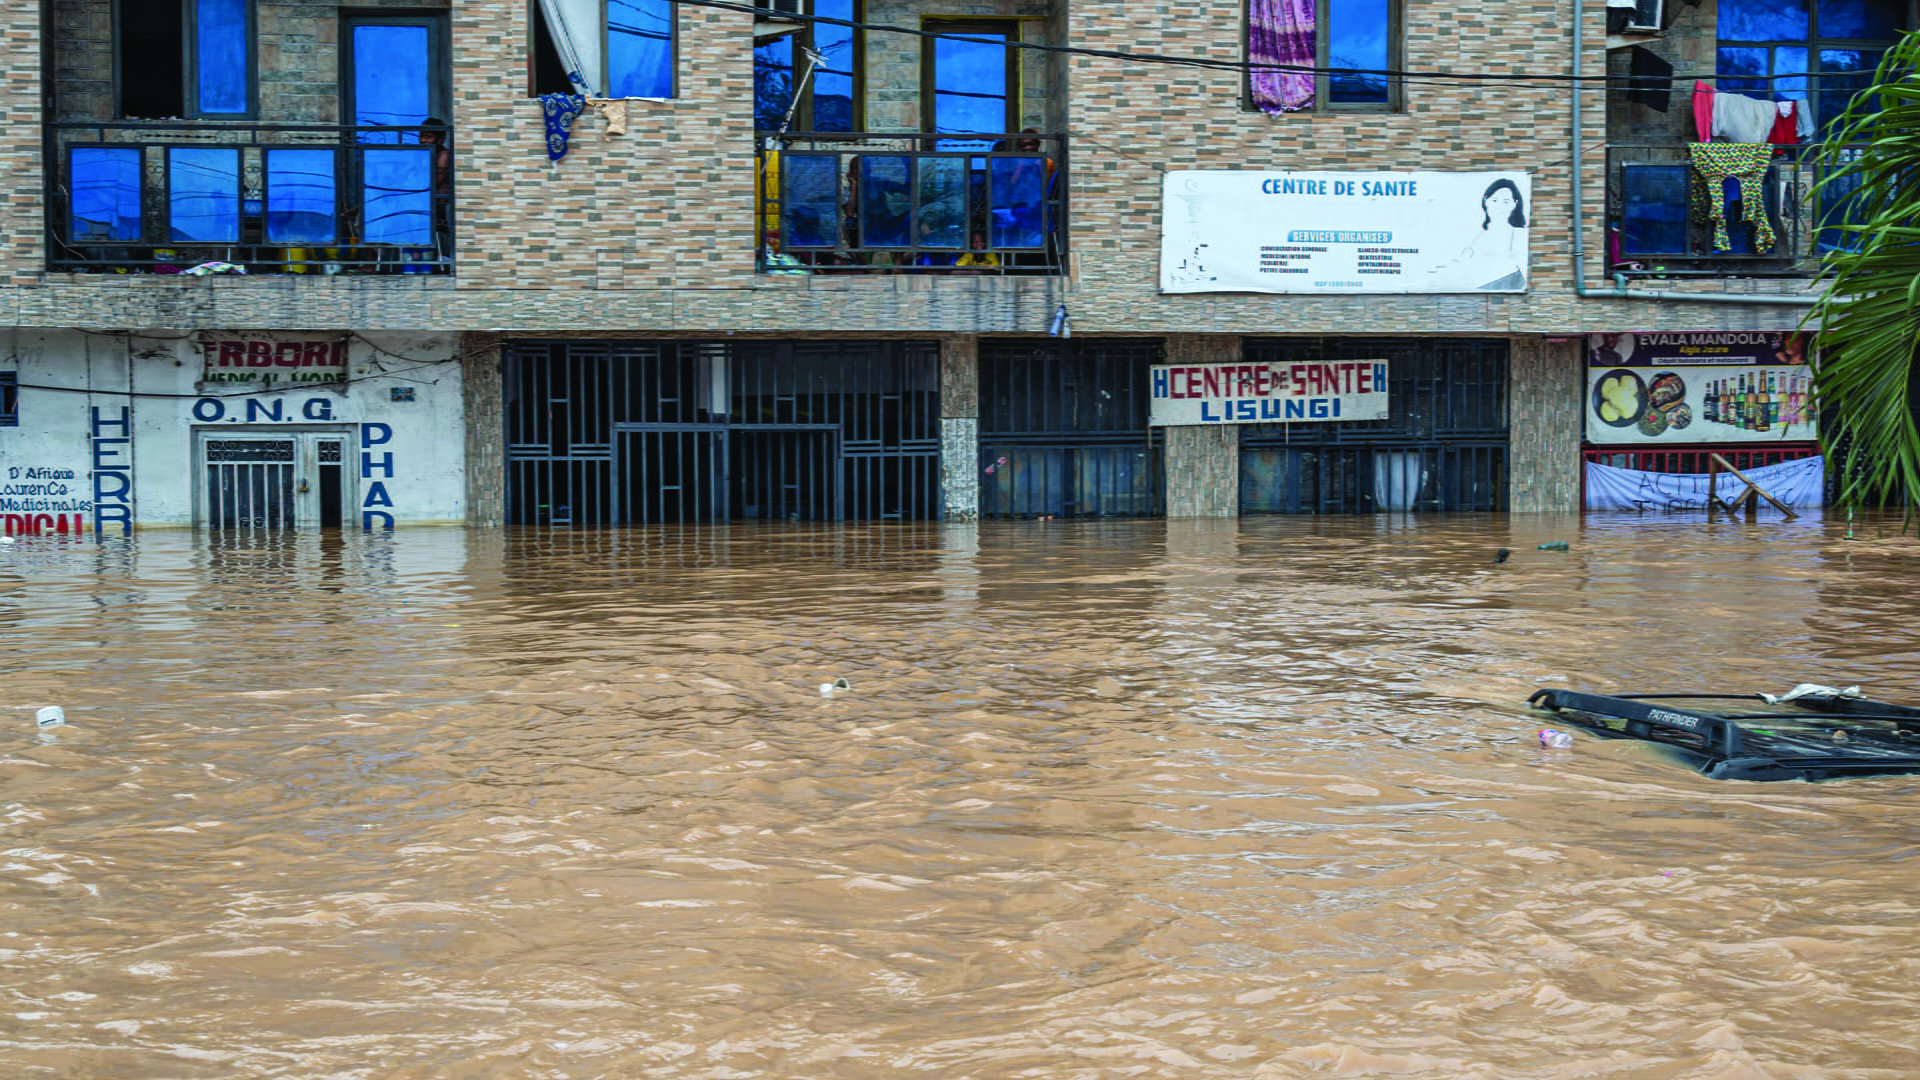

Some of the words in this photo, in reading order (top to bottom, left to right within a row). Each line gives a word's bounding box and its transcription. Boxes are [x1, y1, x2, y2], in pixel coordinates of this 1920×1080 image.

[1261, 178, 1327, 195] CENTRE
[1334, 180, 1355, 196] DE
[1362, 181, 1417, 197] SANTE
[1292, 231, 1335, 241] SERVICES
[1338, 232, 1388, 242] ORGANISES
[1690, 333, 1767, 345] MANDOLA
[1169, 365, 1270, 399] CENTRE
[1291, 363, 1372, 395] SANTE
[1201, 398, 1341, 421] LISUNGI
[1647, 708, 1700, 728] PATHFINDER
